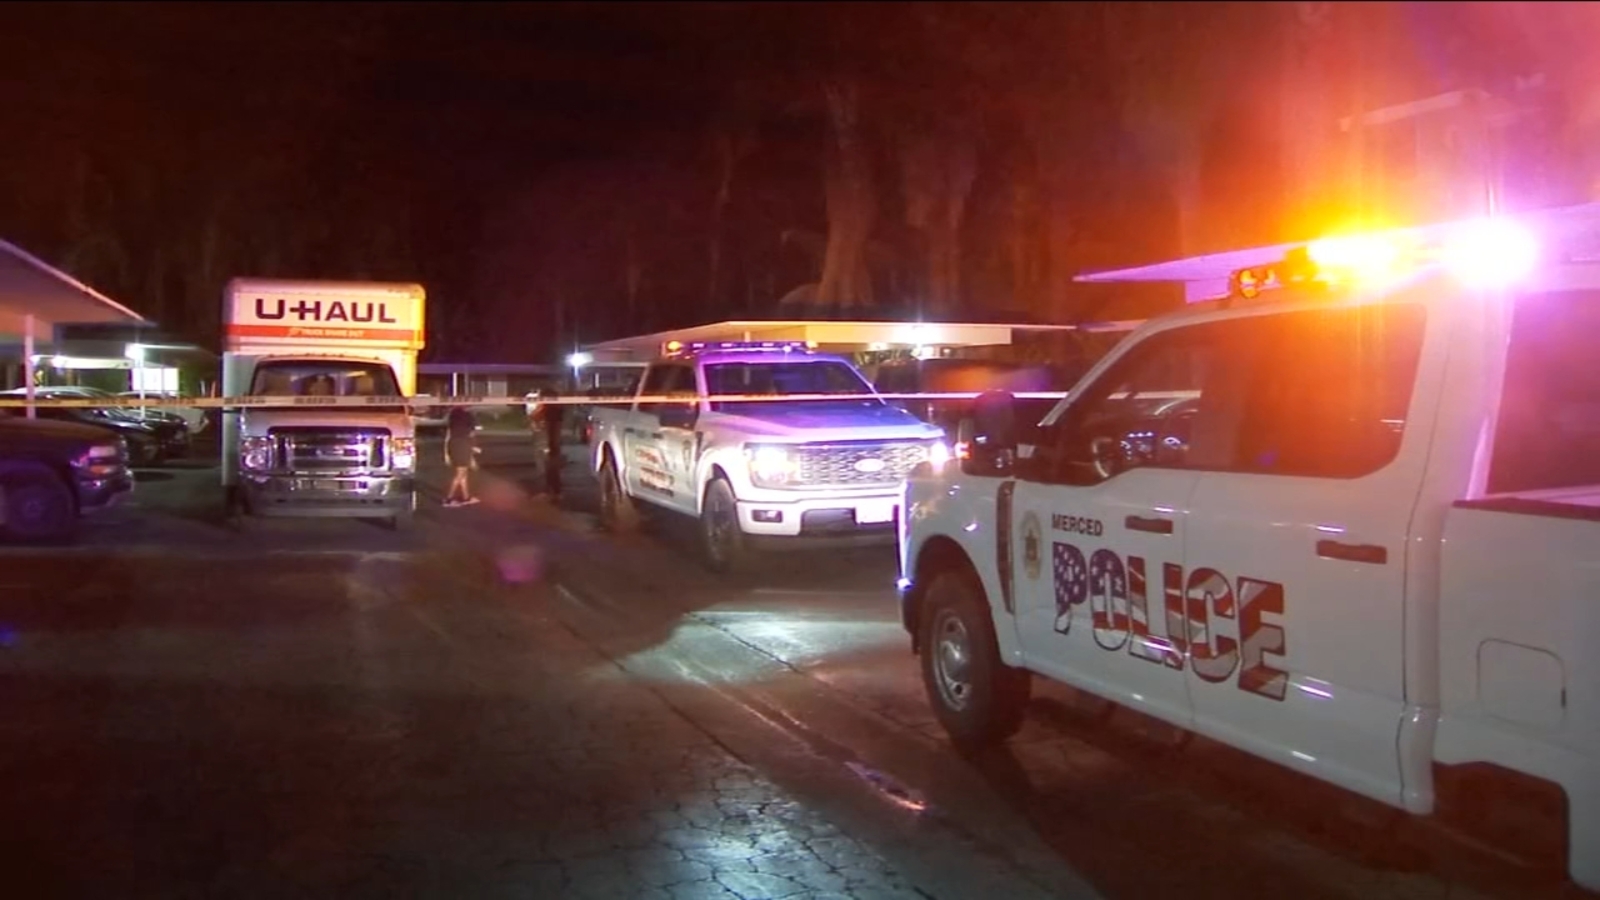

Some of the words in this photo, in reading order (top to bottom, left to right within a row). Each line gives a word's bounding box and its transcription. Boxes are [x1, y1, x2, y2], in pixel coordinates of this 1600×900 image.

[255, 298, 396, 324] U-HAUL
[1052, 514, 1103, 536] MERCED
[1053, 541, 1289, 701] POLICE
